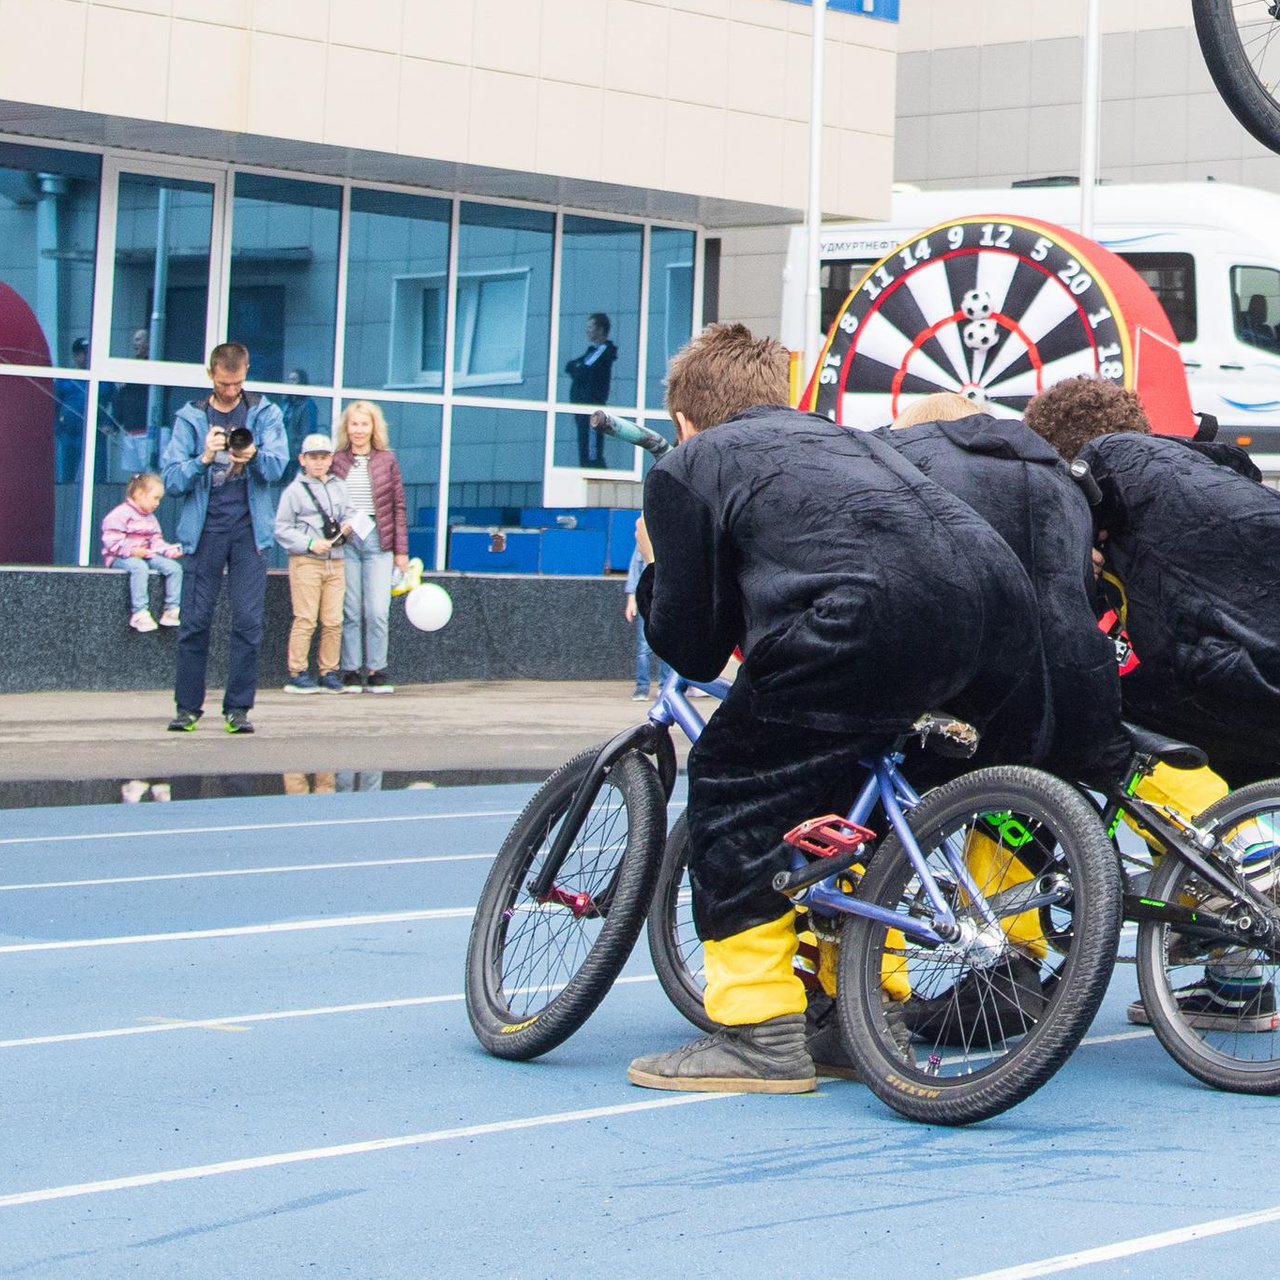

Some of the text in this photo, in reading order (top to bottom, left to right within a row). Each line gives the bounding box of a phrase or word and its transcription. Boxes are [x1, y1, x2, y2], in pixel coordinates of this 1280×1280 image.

[947, 226, 964, 249] 9
[979, 224, 1013, 248] 12
[899, 238, 932, 270] 14
[1030, 238, 1053, 261] 5
[862, 265, 894, 300] 11
[1056, 259, 1092, 295] 20
[840, 312, 859, 334] 8
[1088, 307, 1112, 329] 1
[1098, 342, 1123, 379] 18
